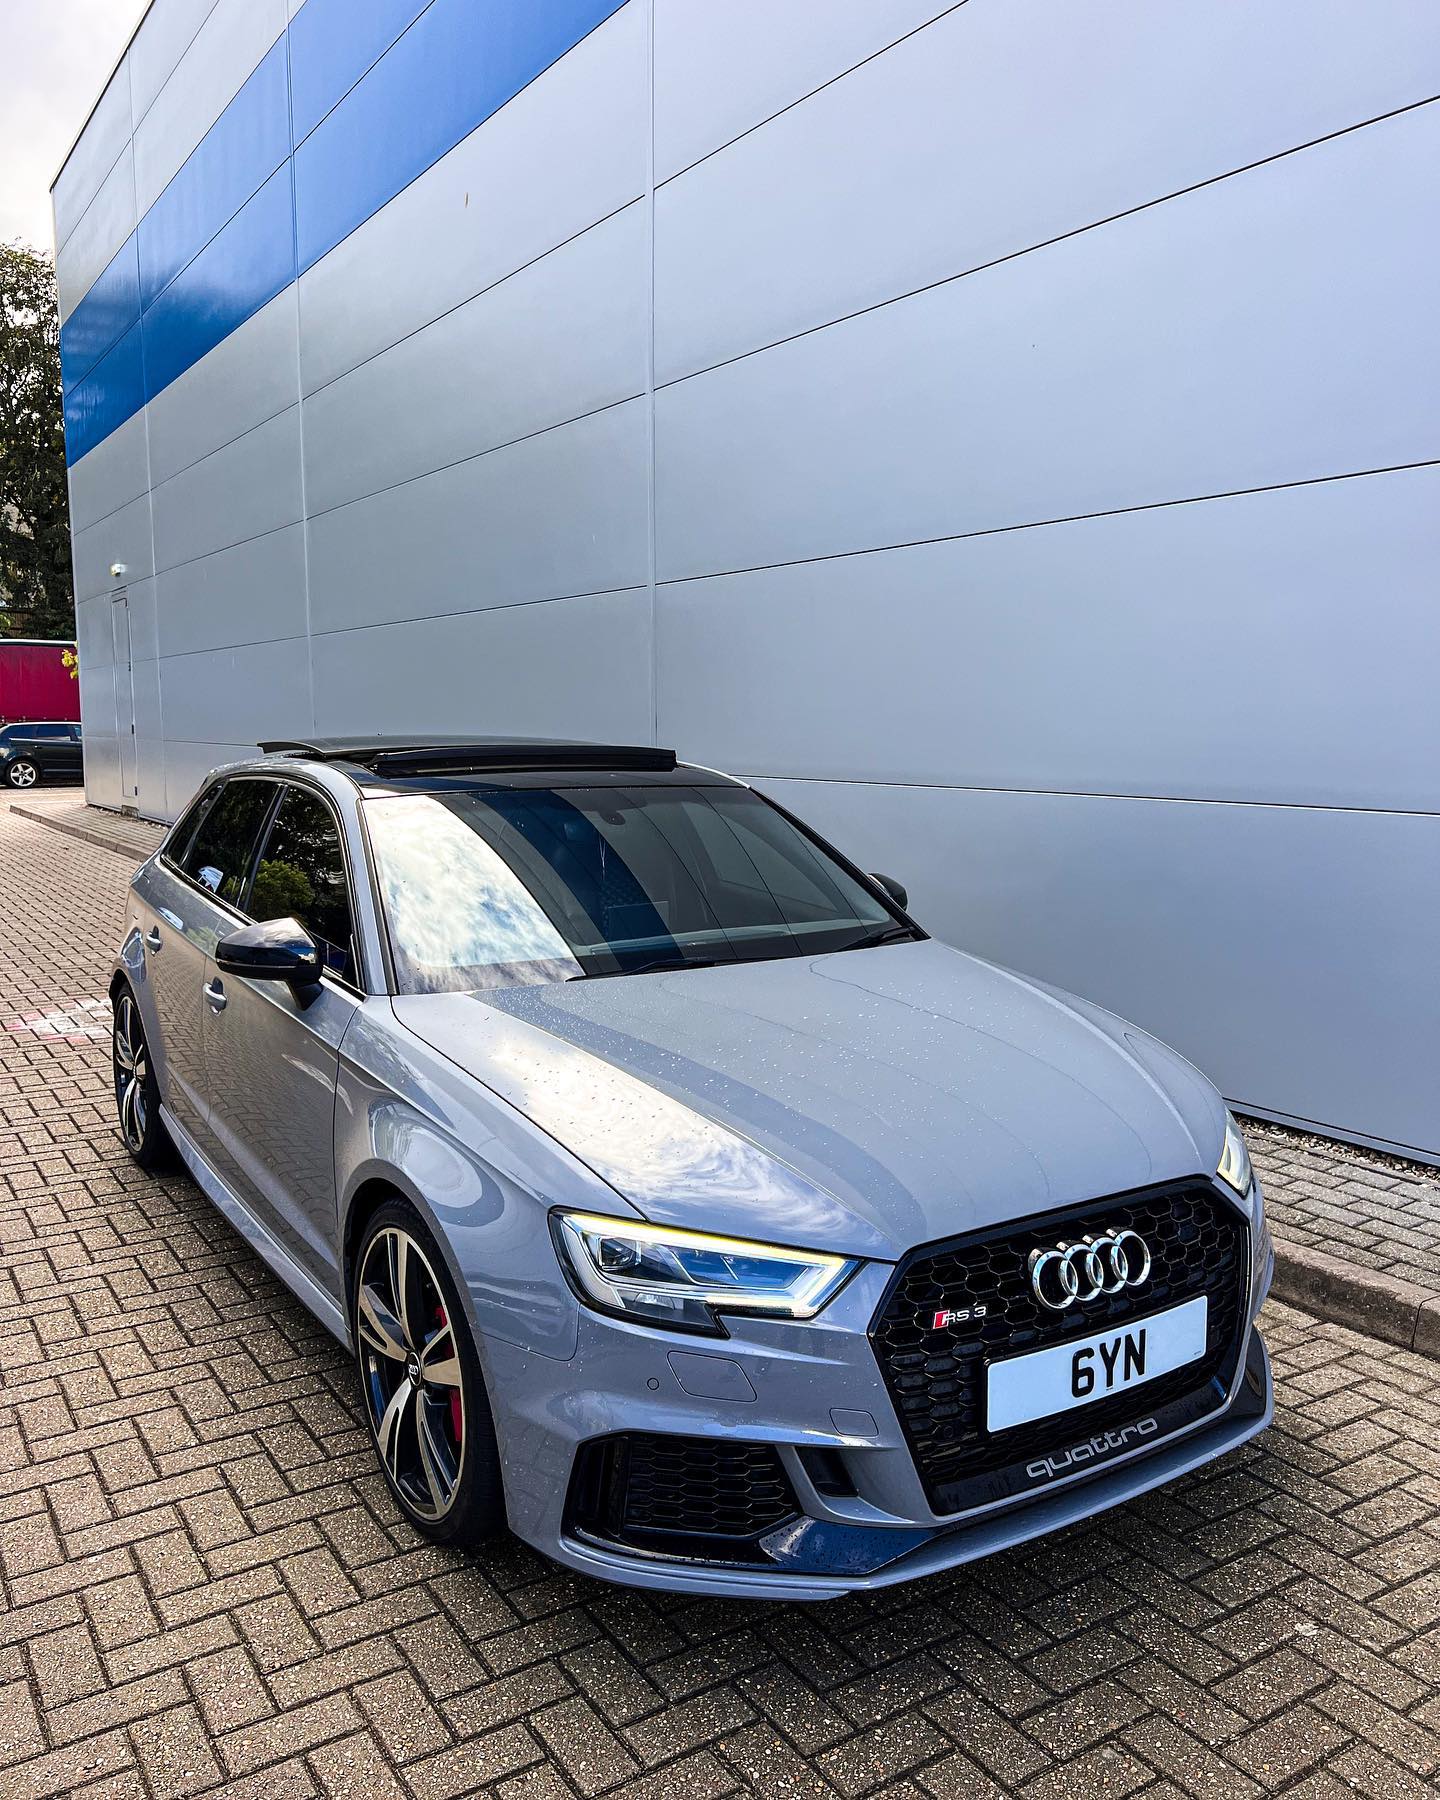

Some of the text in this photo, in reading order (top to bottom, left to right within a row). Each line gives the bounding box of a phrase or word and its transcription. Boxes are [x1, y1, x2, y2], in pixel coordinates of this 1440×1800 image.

[941, 1306, 987, 1326] RS 3
[1071, 1328, 1147, 1398] 6YN
[1026, 1417, 1158, 1478] quattro
